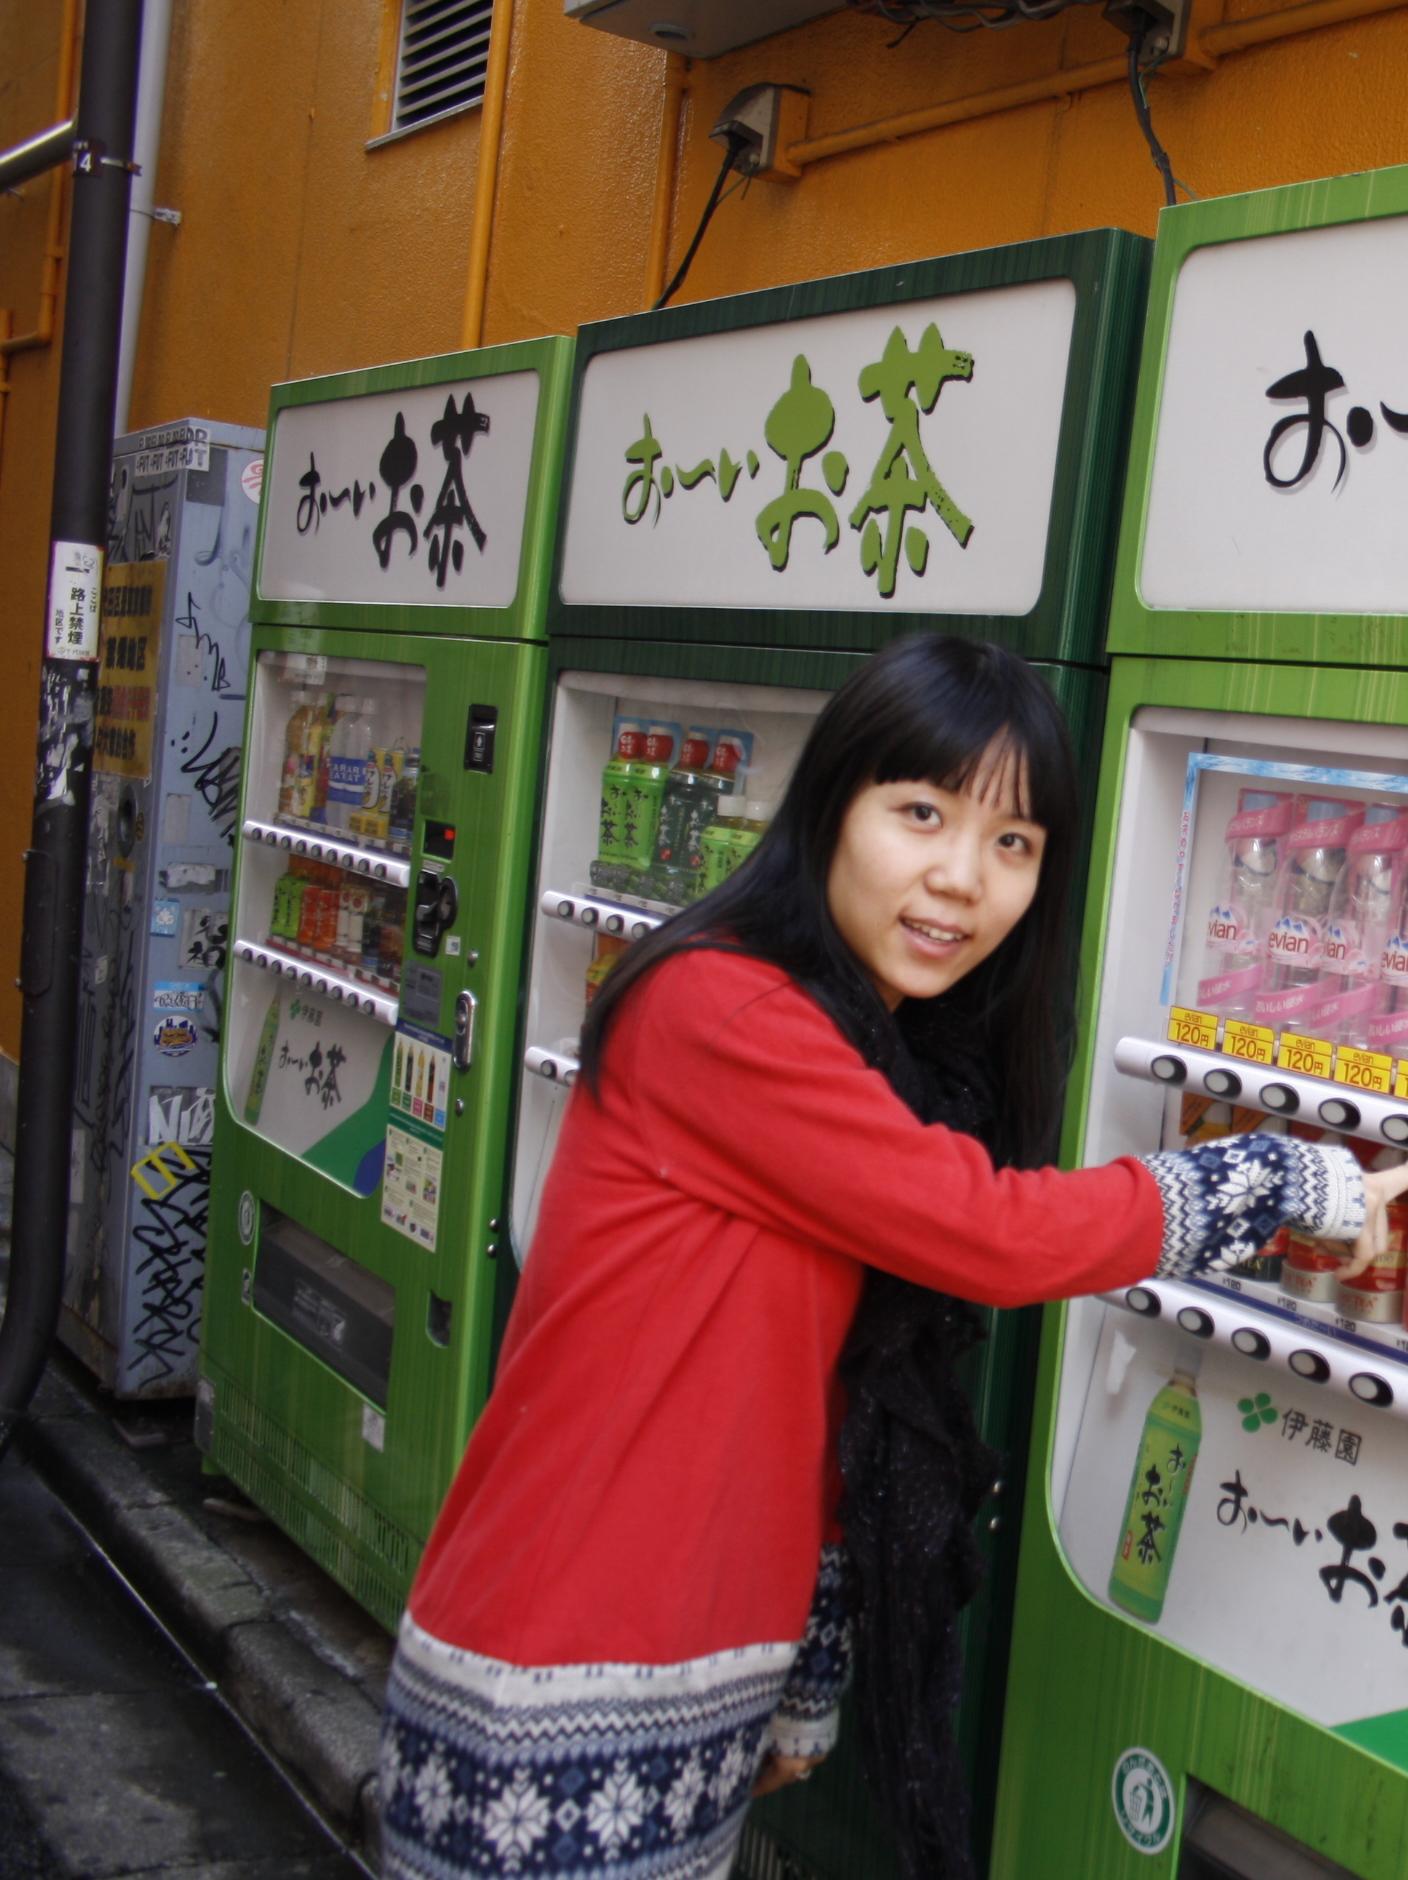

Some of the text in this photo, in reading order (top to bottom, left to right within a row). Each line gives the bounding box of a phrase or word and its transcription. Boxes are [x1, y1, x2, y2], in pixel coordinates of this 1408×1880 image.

[1208, 918, 1237, 941] vian
[1268, 931, 1309, 954] evian
[1327, 939, 1346, 961] ian
[1175, 1022, 1209, 1047] 120円
[1230, 1036, 1266, 1061] 120円
[1286, 1050, 1324, 1075] 120円
[1342, 1062, 1383, 1090] 120円
[1281, 1407, 1362, 1466] 伊藤園
